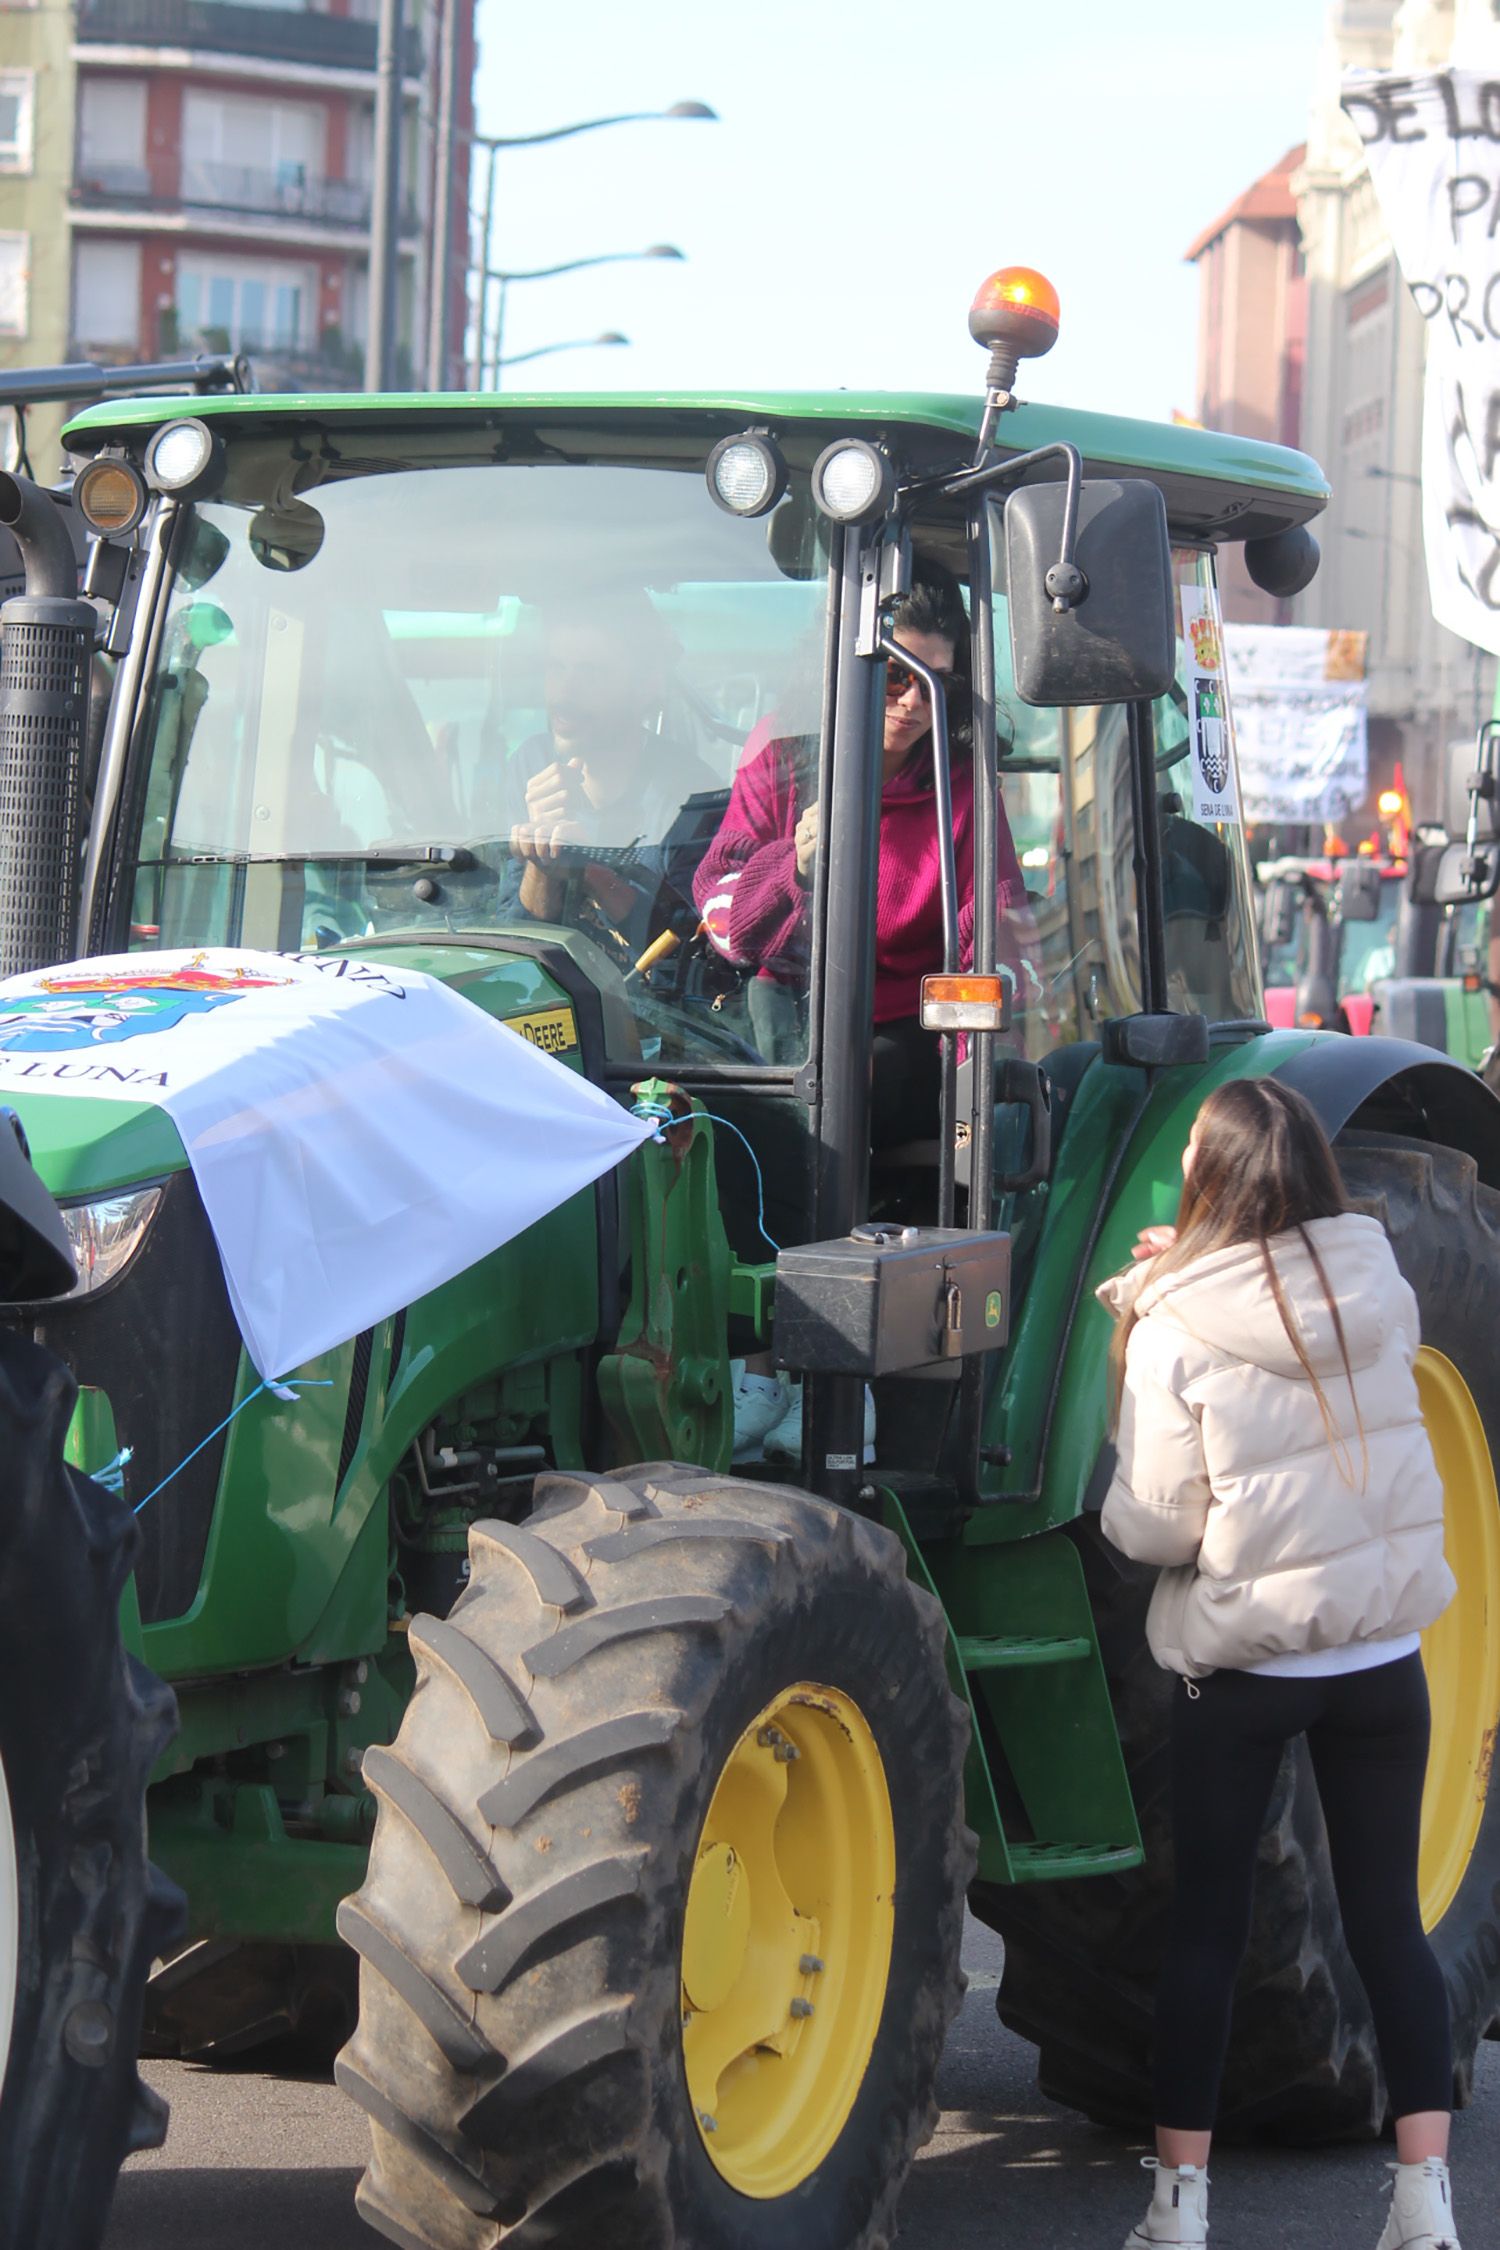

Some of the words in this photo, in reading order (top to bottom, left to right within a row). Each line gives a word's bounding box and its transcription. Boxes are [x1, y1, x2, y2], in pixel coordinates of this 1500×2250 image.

[1214, 803, 1221, 816] DE
[523, 1022, 567, 1050] DEERE
[14, 1062, 169, 1087] LUNA
